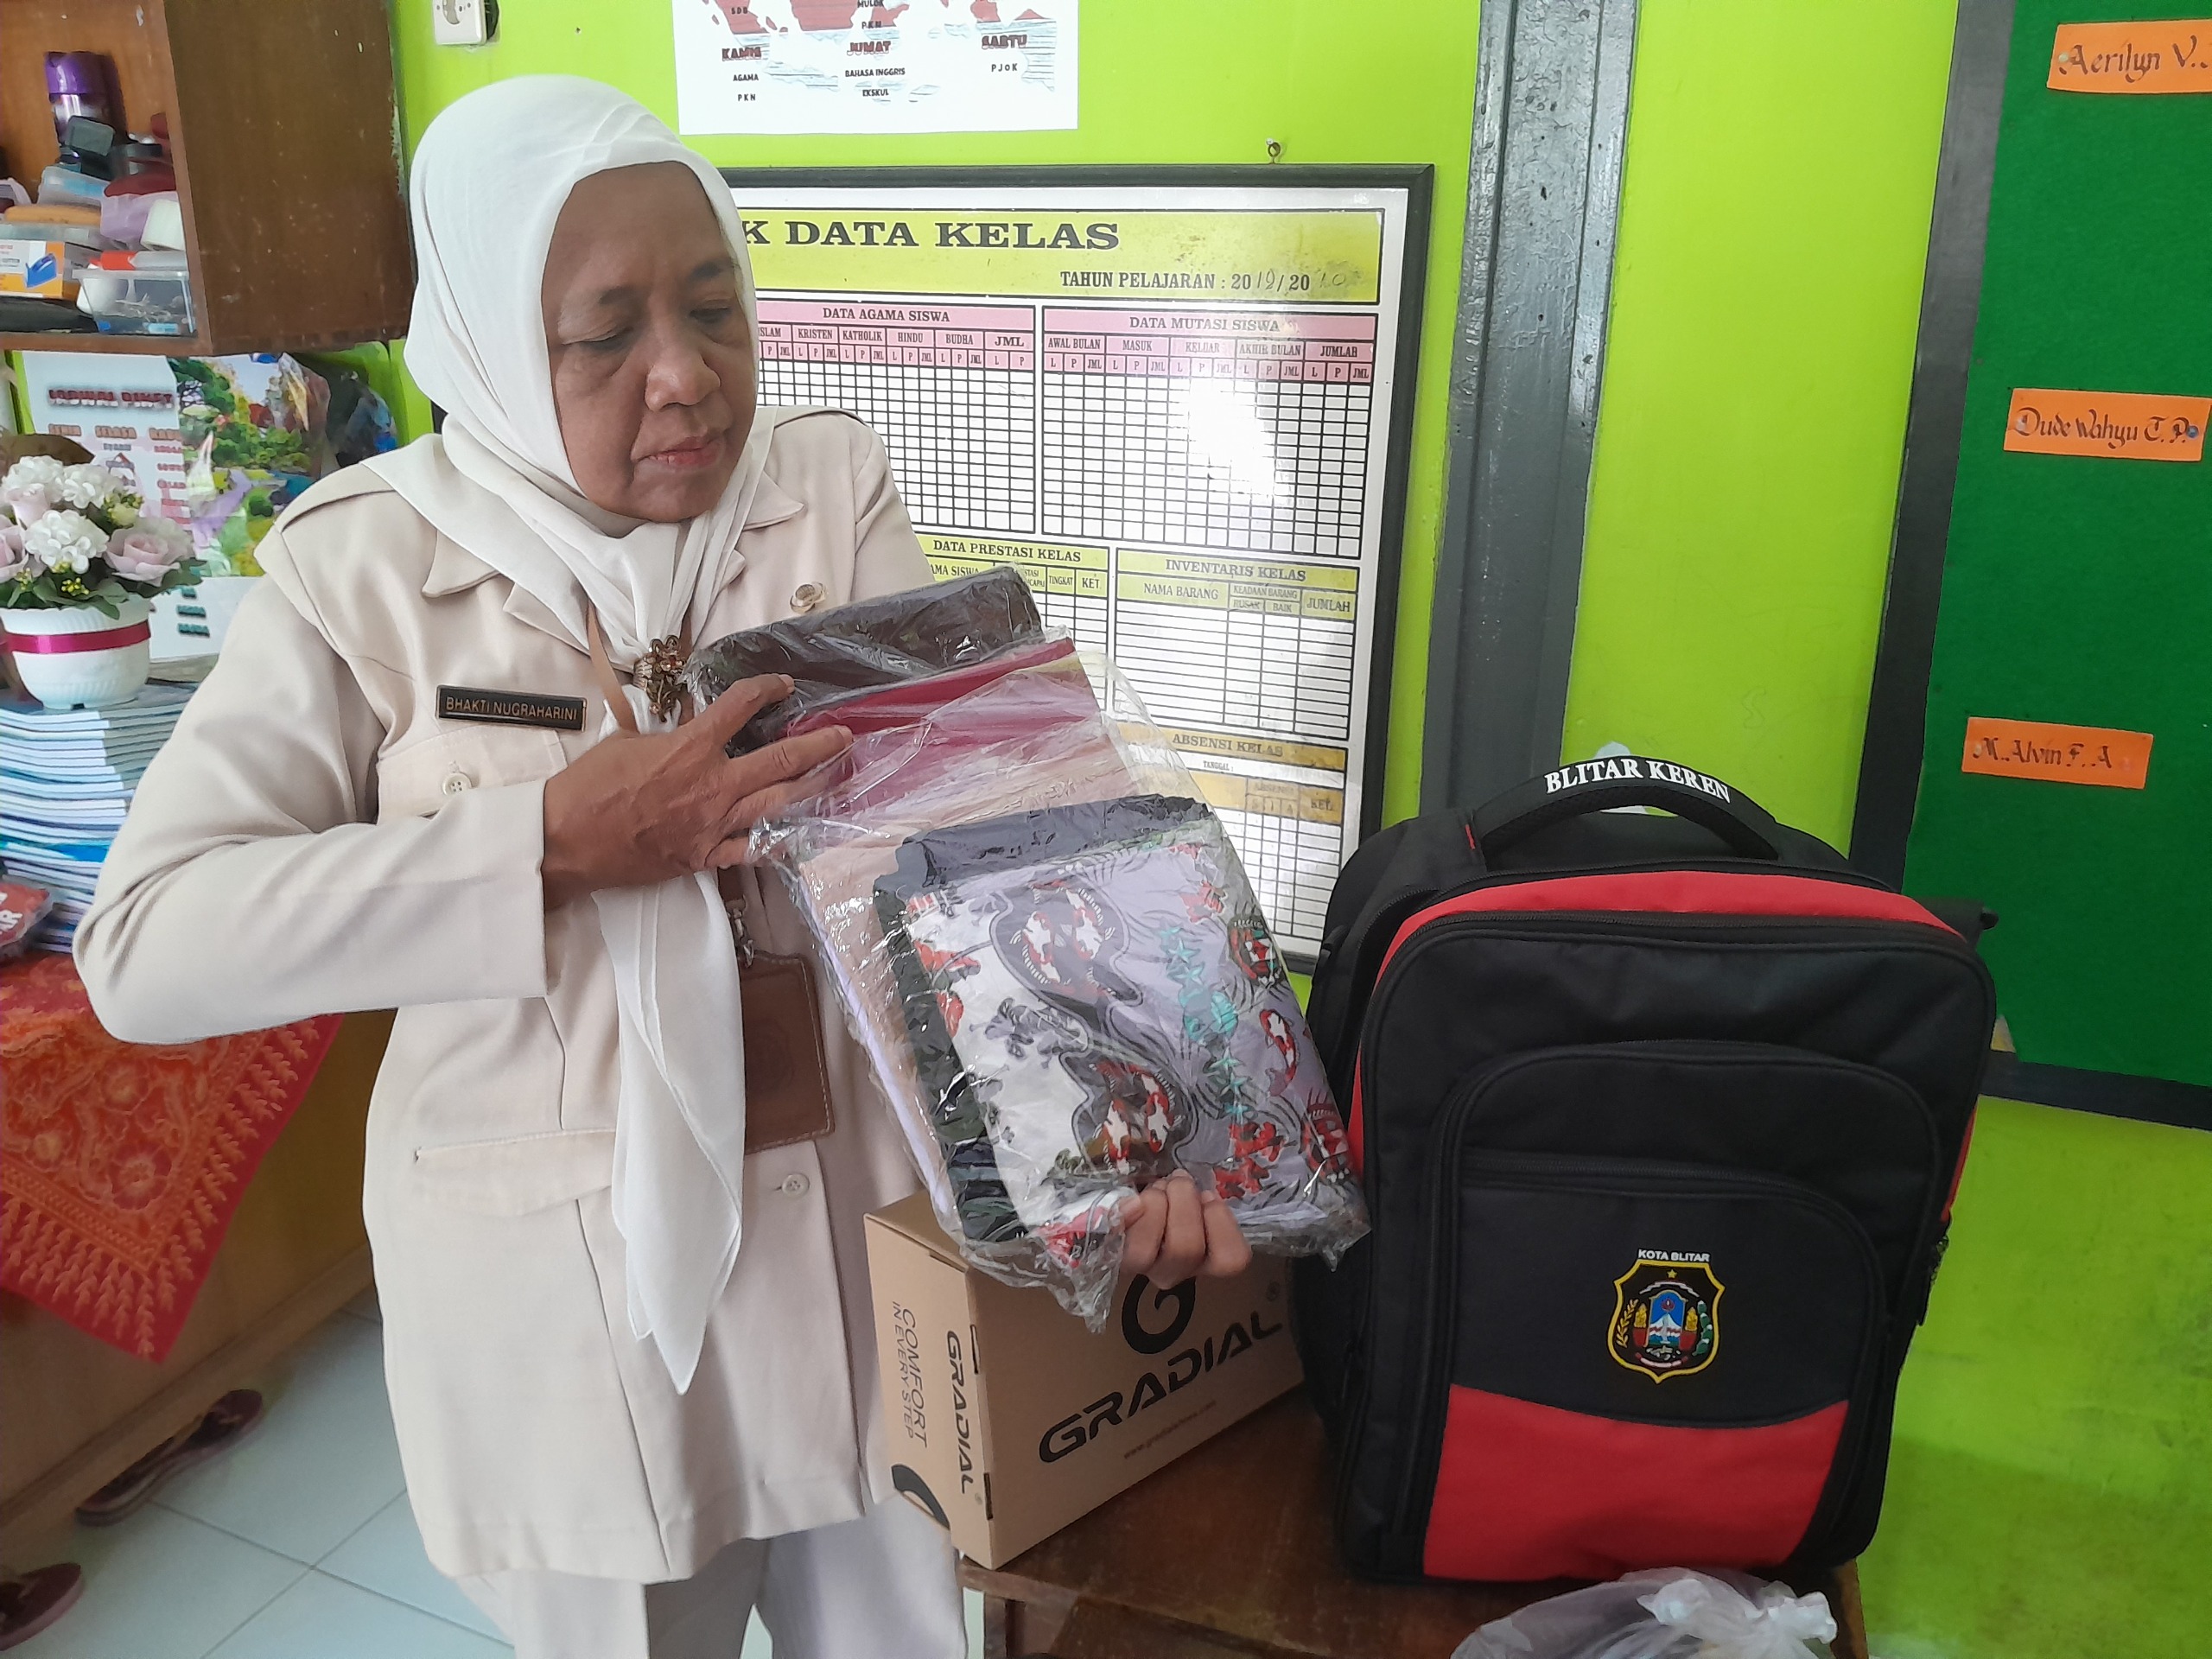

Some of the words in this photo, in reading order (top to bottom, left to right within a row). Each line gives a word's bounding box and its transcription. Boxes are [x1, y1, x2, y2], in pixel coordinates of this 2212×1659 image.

[847, 41, 891, 55] JUMAT
[875, 67, 906, 76] INGGRIS
[733, 73, 760, 82] AGAMA
[785, 221, 919, 246] DATA
[935, 223, 1120, 251] KELAS
[1060, 270, 1114, 288] TAHUN
[1118, 272, 1215, 290] PELAJARAN
[823, 308, 855, 319] DATA
[859, 308, 906, 321] AGAMA
[908, 311, 950, 322] SISWA
[1129, 316, 1166, 328] DATA
[1171, 318, 1227, 331] MUTASI
[1232, 319, 1280, 332] SISWA
[798, 328, 833, 340] KRISTEN
[842, 330, 882, 341] KATHOLIK
[898, 332, 924, 343] HINDU
[945, 334, 974, 345] BUDHA
[995, 336, 1025, 346] JML
[1048, 338, 1071, 348] AWAL
[1073, 339, 1101, 350] BULAN
[1122, 340, 1152, 351] MASUK
[767, 346, 772, 355] P
[798, 346, 803, 357] L
[814, 348, 818, 357] P
[1185, 341, 1220, 353] KELUAR
[1239, 345, 1268, 355] AKHIR
[1271, 345, 1300, 356] BULAN
[1320, 346, 1357, 358] JUMLAH
[845, 349, 849, 359] L
[861, 350, 865, 359] P
[893, 351, 897, 360] L
[908, 352, 913, 361] P
[941, 353, 945, 363] L
[957, 353, 962, 363] P
[995, 355, 999, 365] L
[1020, 357, 1024, 366] P
[1051, 357, 1056, 367] L
[1071, 359, 1077, 368] P
[1113, 359, 1118, 370] L
[1134, 360, 1140, 371] P
[1177, 362, 1183, 372] L
[1199, 363, 1205, 372] P
[1243, 364, 1249, 374] L
[1266, 365, 1272, 375] P
[1312, 367, 1318, 378] L
[1334, 367, 1341, 378] P
[2075, 409, 2138, 449] Wahyu
[933, 539, 966, 553] DATA
[969, 543, 1033, 559] PRESTASI
[1037, 550, 1081, 563] KELAS
[1166, 558, 1253, 577] INVENTARIS
[1257, 566, 1306, 582] KELAS
[1048, 575, 1073, 587] TINGKAT
[1144, 583, 1173, 596] NAMA
[1176, 585, 1219, 600] BARANG
[1233, 585, 1268, 596] KEADAAN
[1268, 588, 1298, 600] BARANG
[1273, 602, 1293, 613] BAIK
[1306, 597, 1351, 613] JUMLAH
[446, 696, 490, 713] BHAKTI
[493, 701, 577, 721] NUGRAHARINI
[1172, 734, 1232, 751] ABSENSI
[1236, 741, 1283, 757] KELAS
[1544, 759, 1644, 794] BLITAR
[1645, 760, 1731, 804] KEREN
[1637, 1249, 1669, 1261] KOTA
[1670, 1252, 1710, 1262] BLITAR
[893, 1300, 902, 1319] IN
[894, 1325, 910, 1387] EVERY
[902, 1308, 928, 1448] COMFORT
[1039, 1311, 1283, 1463] GRADIAL
[901, 1389, 913, 1440] STEP
[947, 1330, 974, 1495] GRADIAL
